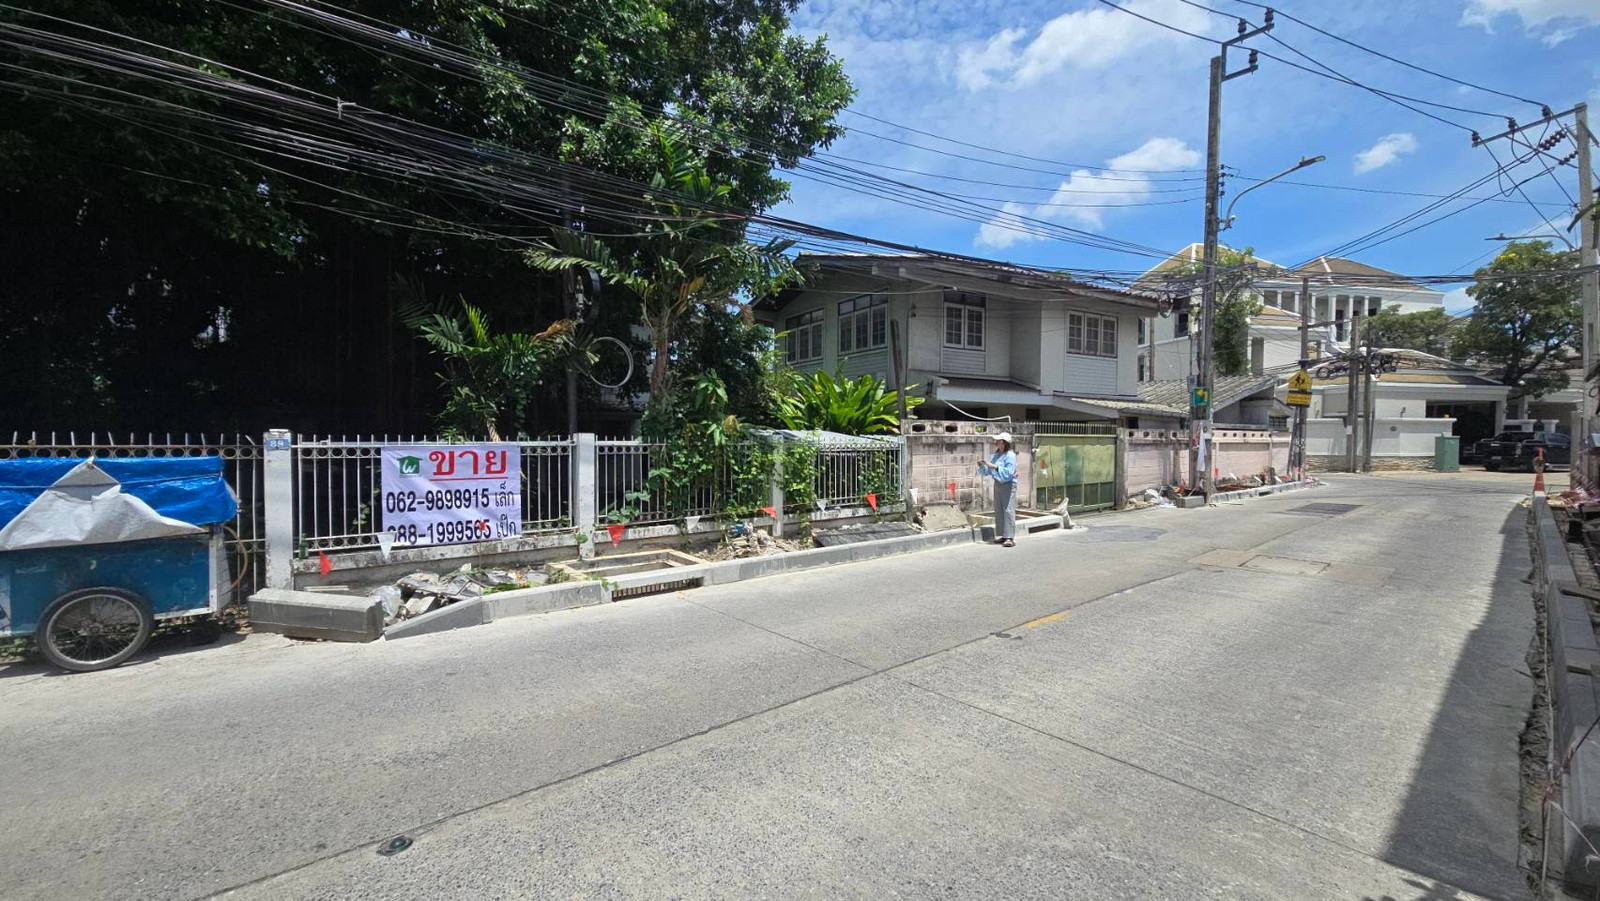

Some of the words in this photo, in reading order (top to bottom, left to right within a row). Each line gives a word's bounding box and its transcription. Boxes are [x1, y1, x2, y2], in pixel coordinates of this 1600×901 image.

[428, 450, 507, 476] ขาย
[386, 488, 490, 513] 062-9898915
[495, 481, 515, 508] เล็ก
